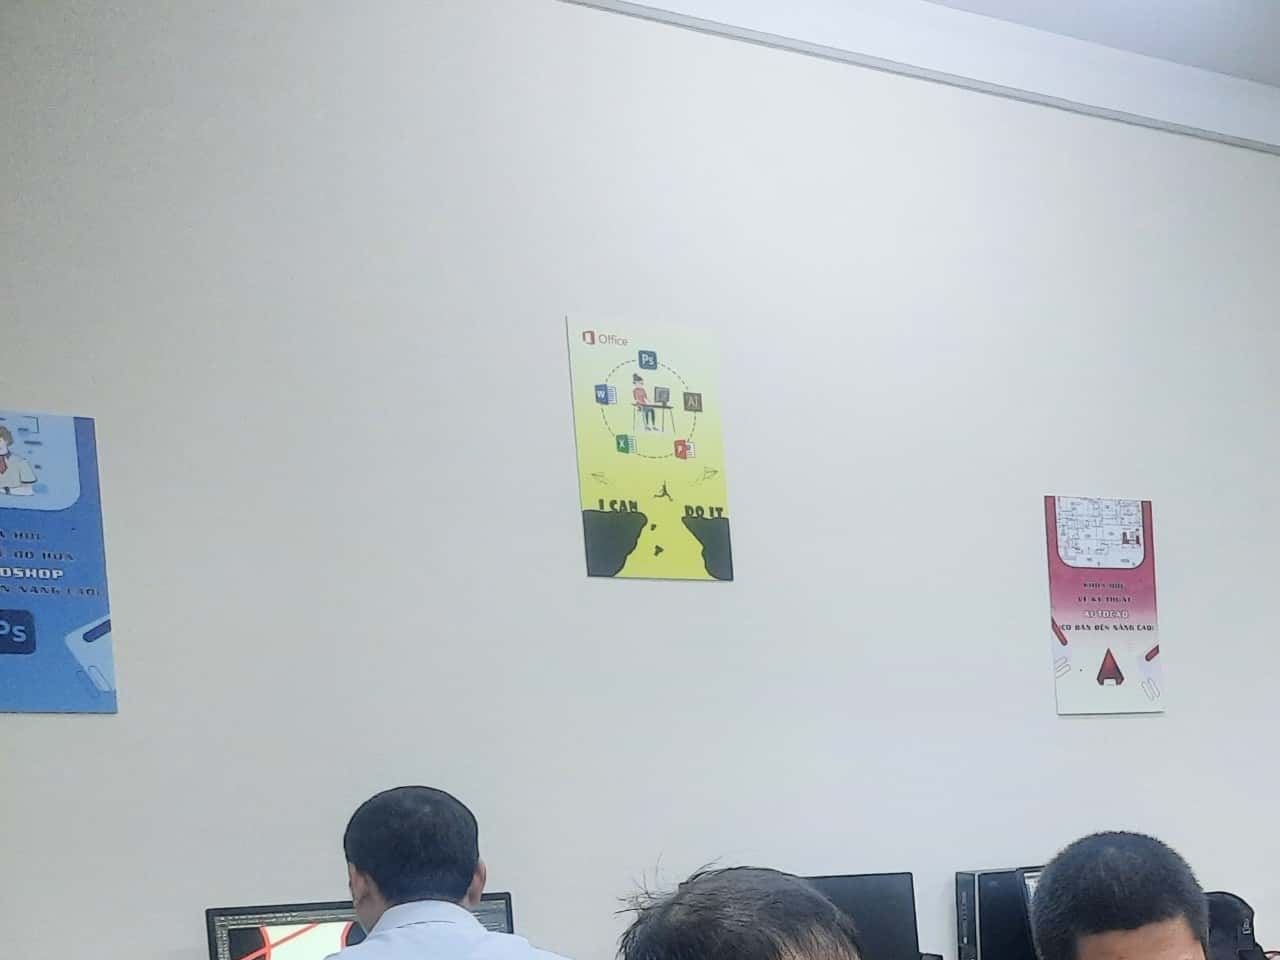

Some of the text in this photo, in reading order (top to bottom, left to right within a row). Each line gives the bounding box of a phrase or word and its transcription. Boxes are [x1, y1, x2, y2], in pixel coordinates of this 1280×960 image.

[598, 333, 629, 346] Office
[609, 499, 638, 512] CAN
[684, 505, 724, 518] DO IT
